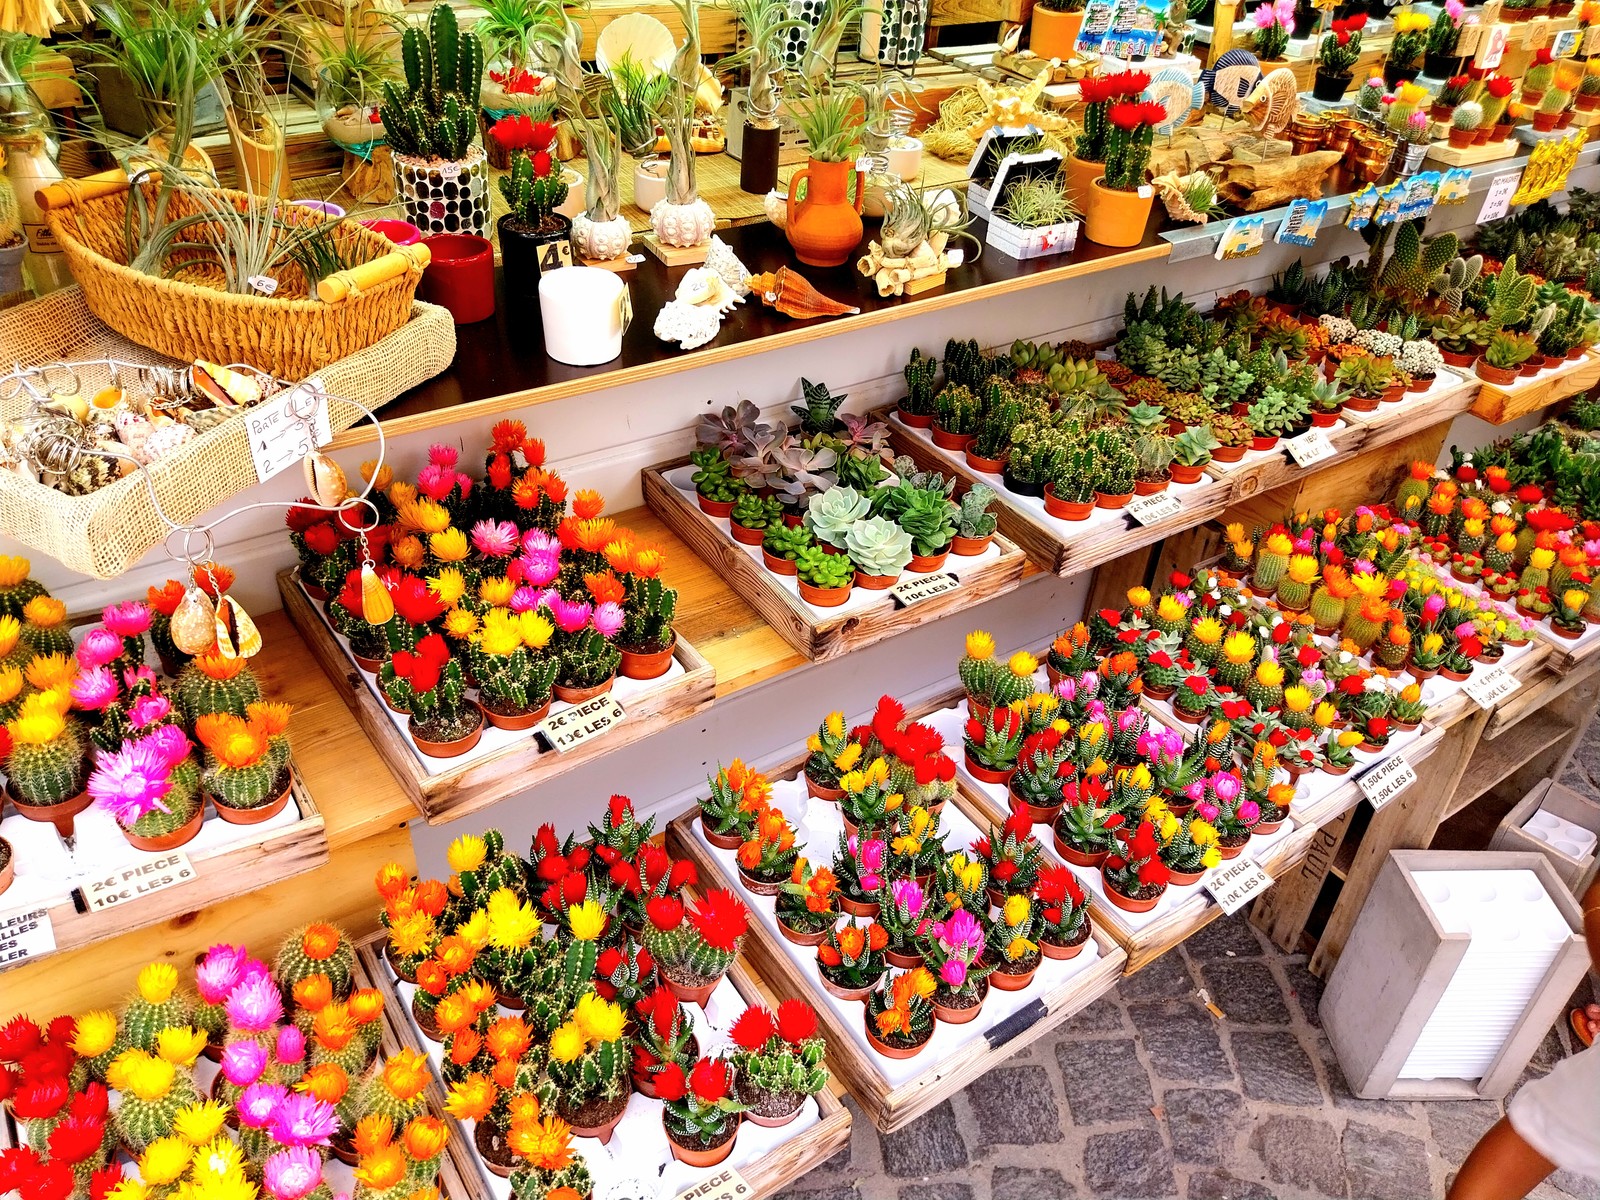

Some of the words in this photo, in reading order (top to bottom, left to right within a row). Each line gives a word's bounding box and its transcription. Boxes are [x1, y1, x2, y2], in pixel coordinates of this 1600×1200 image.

[252, 411, 279, 435] PORTE
[263, 459, 274, 473] 2
[1140, 512, 1158, 523] 10€
[1172, 502, 1180, 510] 6
[1142, 494, 1168, 508] PIECE
[896, 583, 912, 593] 2€
[912, 573, 946, 588] PIECE
[904, 591, 927, 602] 10€
[926, 583, 948, 595] LES
[548, 716, 568, 731] 2€
[567, 696, 610, 722] PIECE
[583, 716, 612, 734] LES
[612, 708, 622, 718] 6
[1362, 771, 1384, 791] 1,50€
[1380, 755, 1404, 776] PIECE
[1371, 785, 1394, 805] 7,50€
[1391, 774, 1407, 790] LES
[1405, 769, 1413, 779] 6
[91, 876, 118, 893] 2€
[121, 854, 181, 882] PIECE
[1210, 877, 1226, 892] 2€
[1222, 858, 1252, 882] PIECE
[1238, 877, 1259, 894] LES
[1256, 871, 1266, 881] 6
[93, 889, 132, 907] 10€
[136, 874, 174, 894] LES
[178, 868, 191, 878] 6
[683, 1170, 733, 1200] PIECE
[735, 1183, 747, 1194] 6
